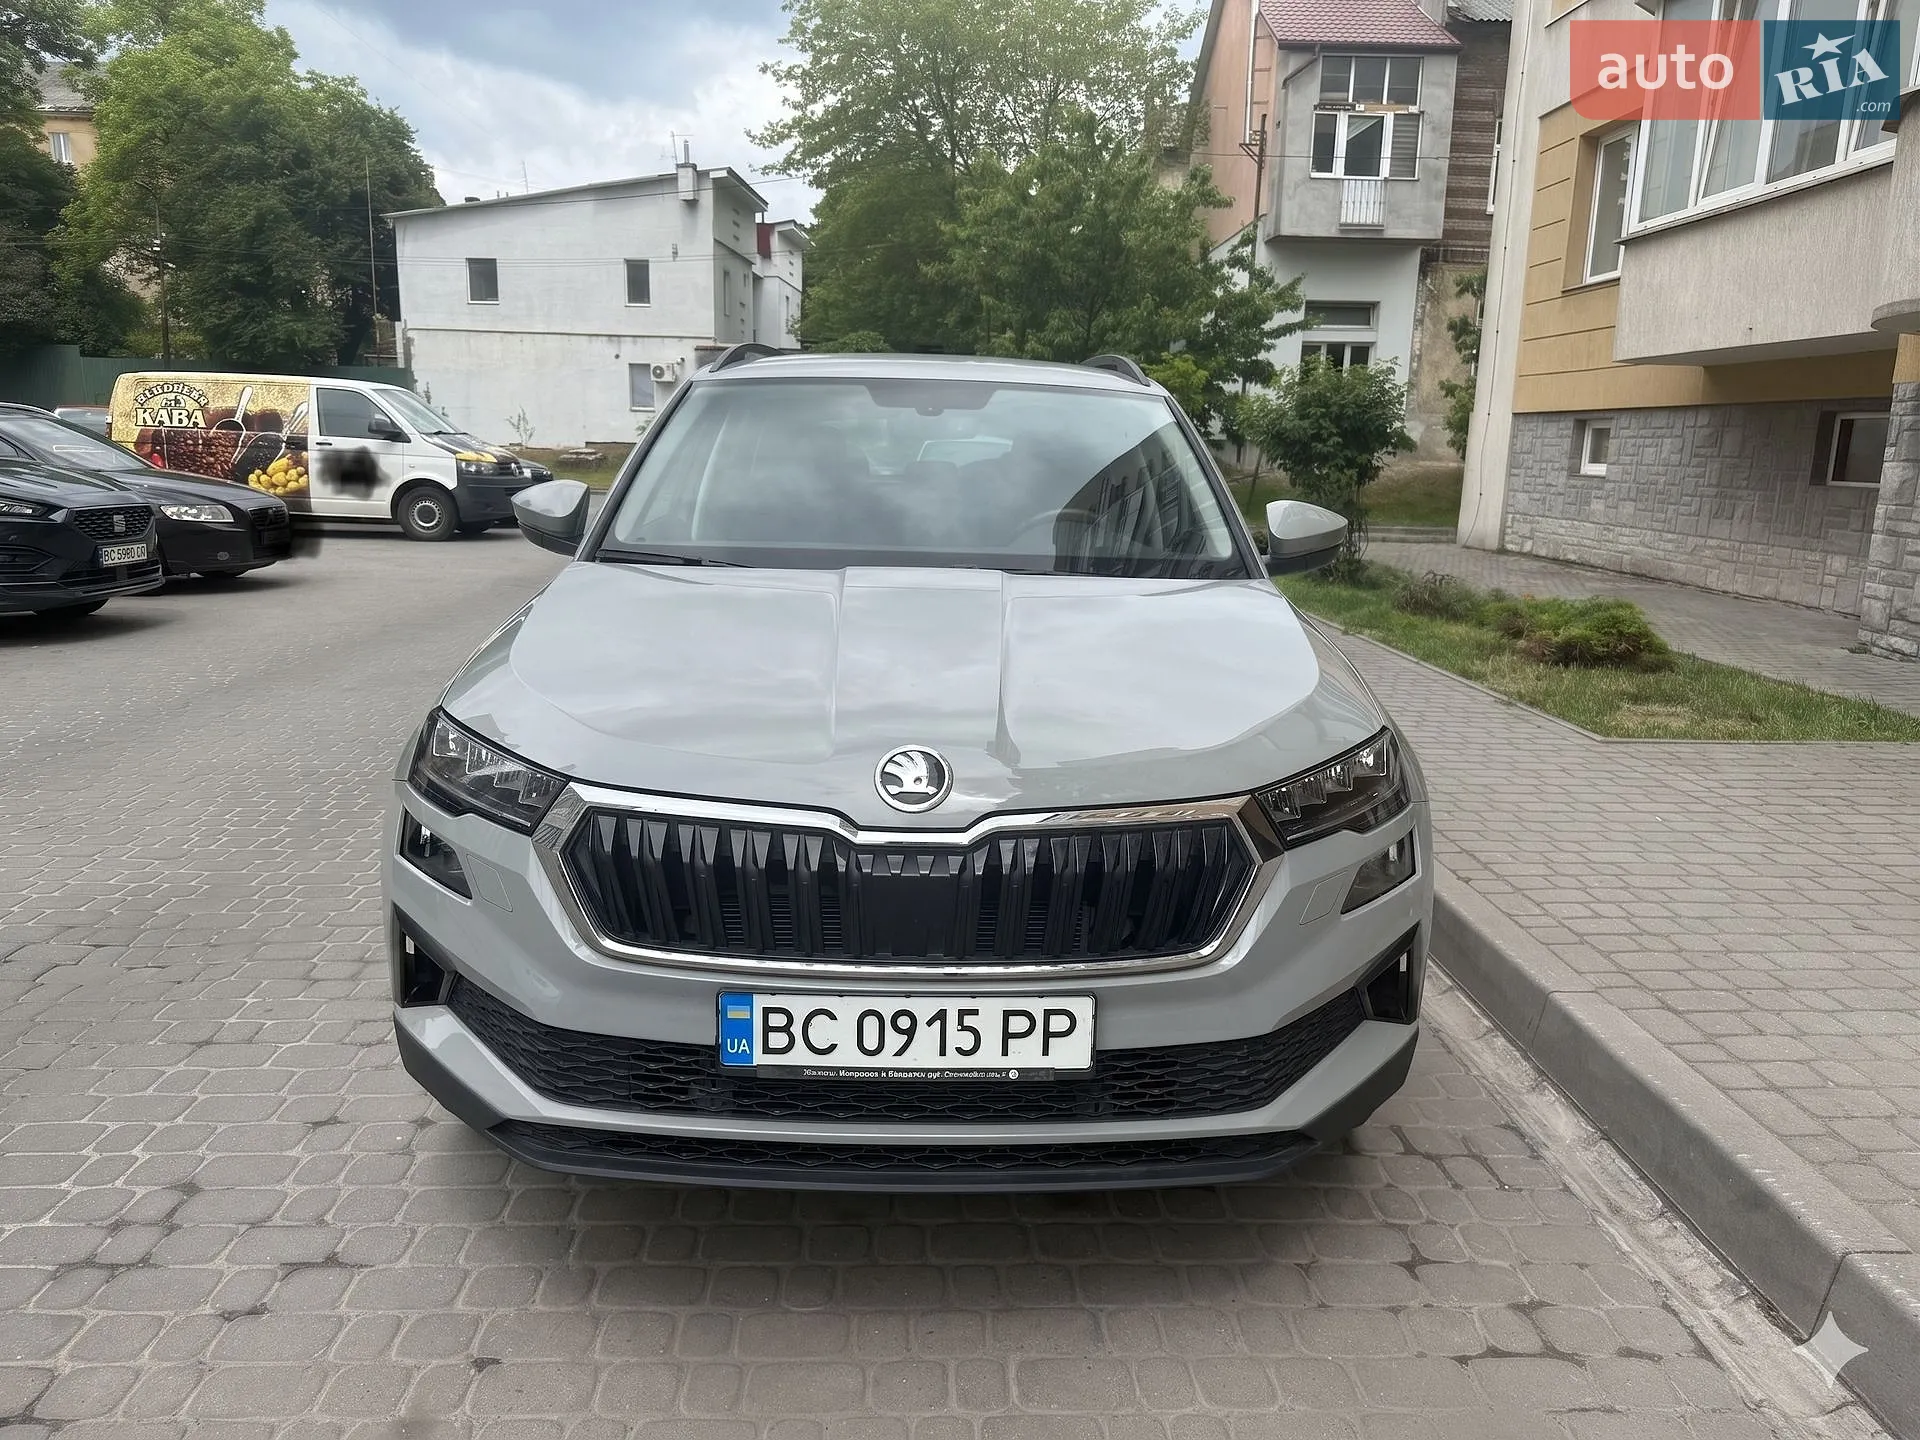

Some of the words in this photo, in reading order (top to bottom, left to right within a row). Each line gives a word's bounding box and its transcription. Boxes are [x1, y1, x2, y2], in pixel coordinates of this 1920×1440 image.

[727, 1038, 750, 1054] UA
[761, 1006, 839, 1055] BC
[856, 1008, 982, 1057] 0915
[1001, 1009, 1077, 1056] PP
